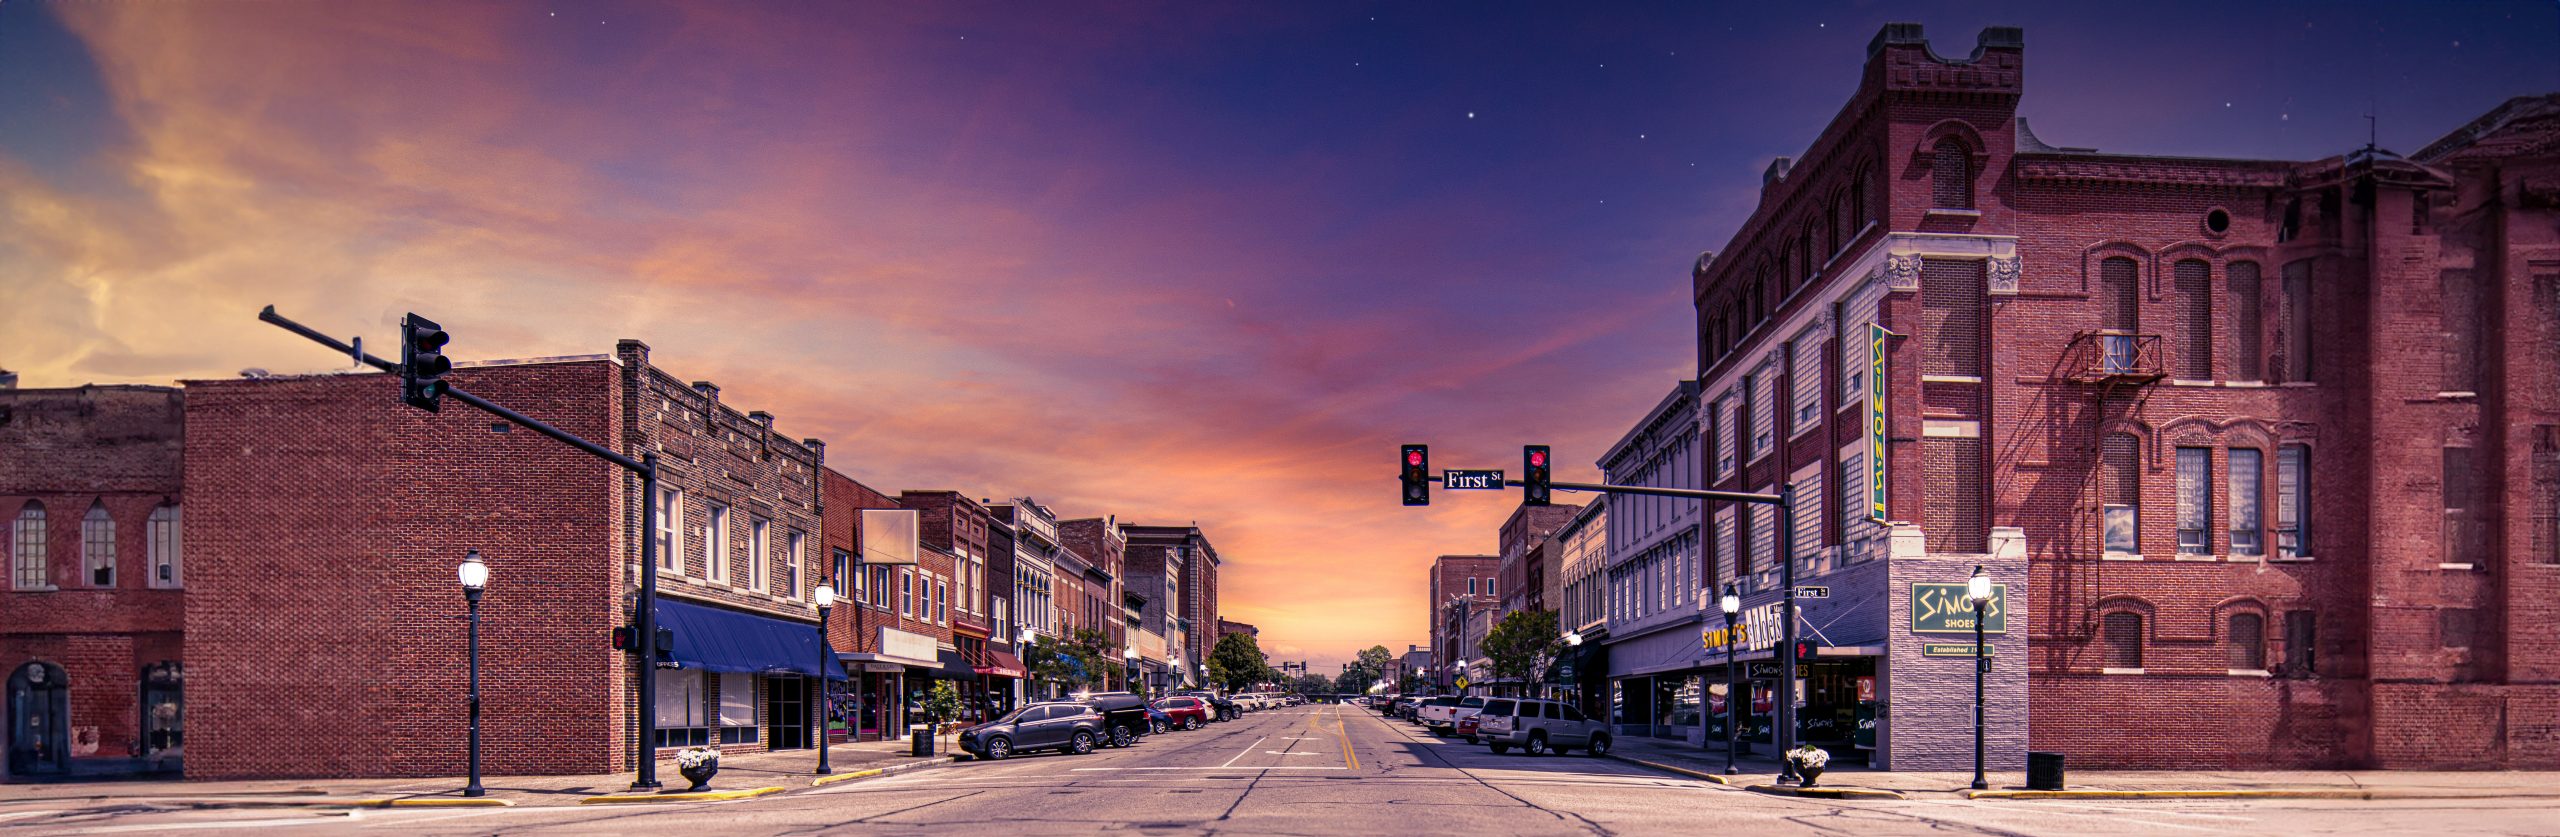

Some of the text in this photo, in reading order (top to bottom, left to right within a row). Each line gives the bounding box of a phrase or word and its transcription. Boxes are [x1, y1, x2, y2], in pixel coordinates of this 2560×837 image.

[1447, 471, 1501, 488] First St
[1797, 586, 1818, 597] First
[1945, 619, 1975, 628] SHOES
